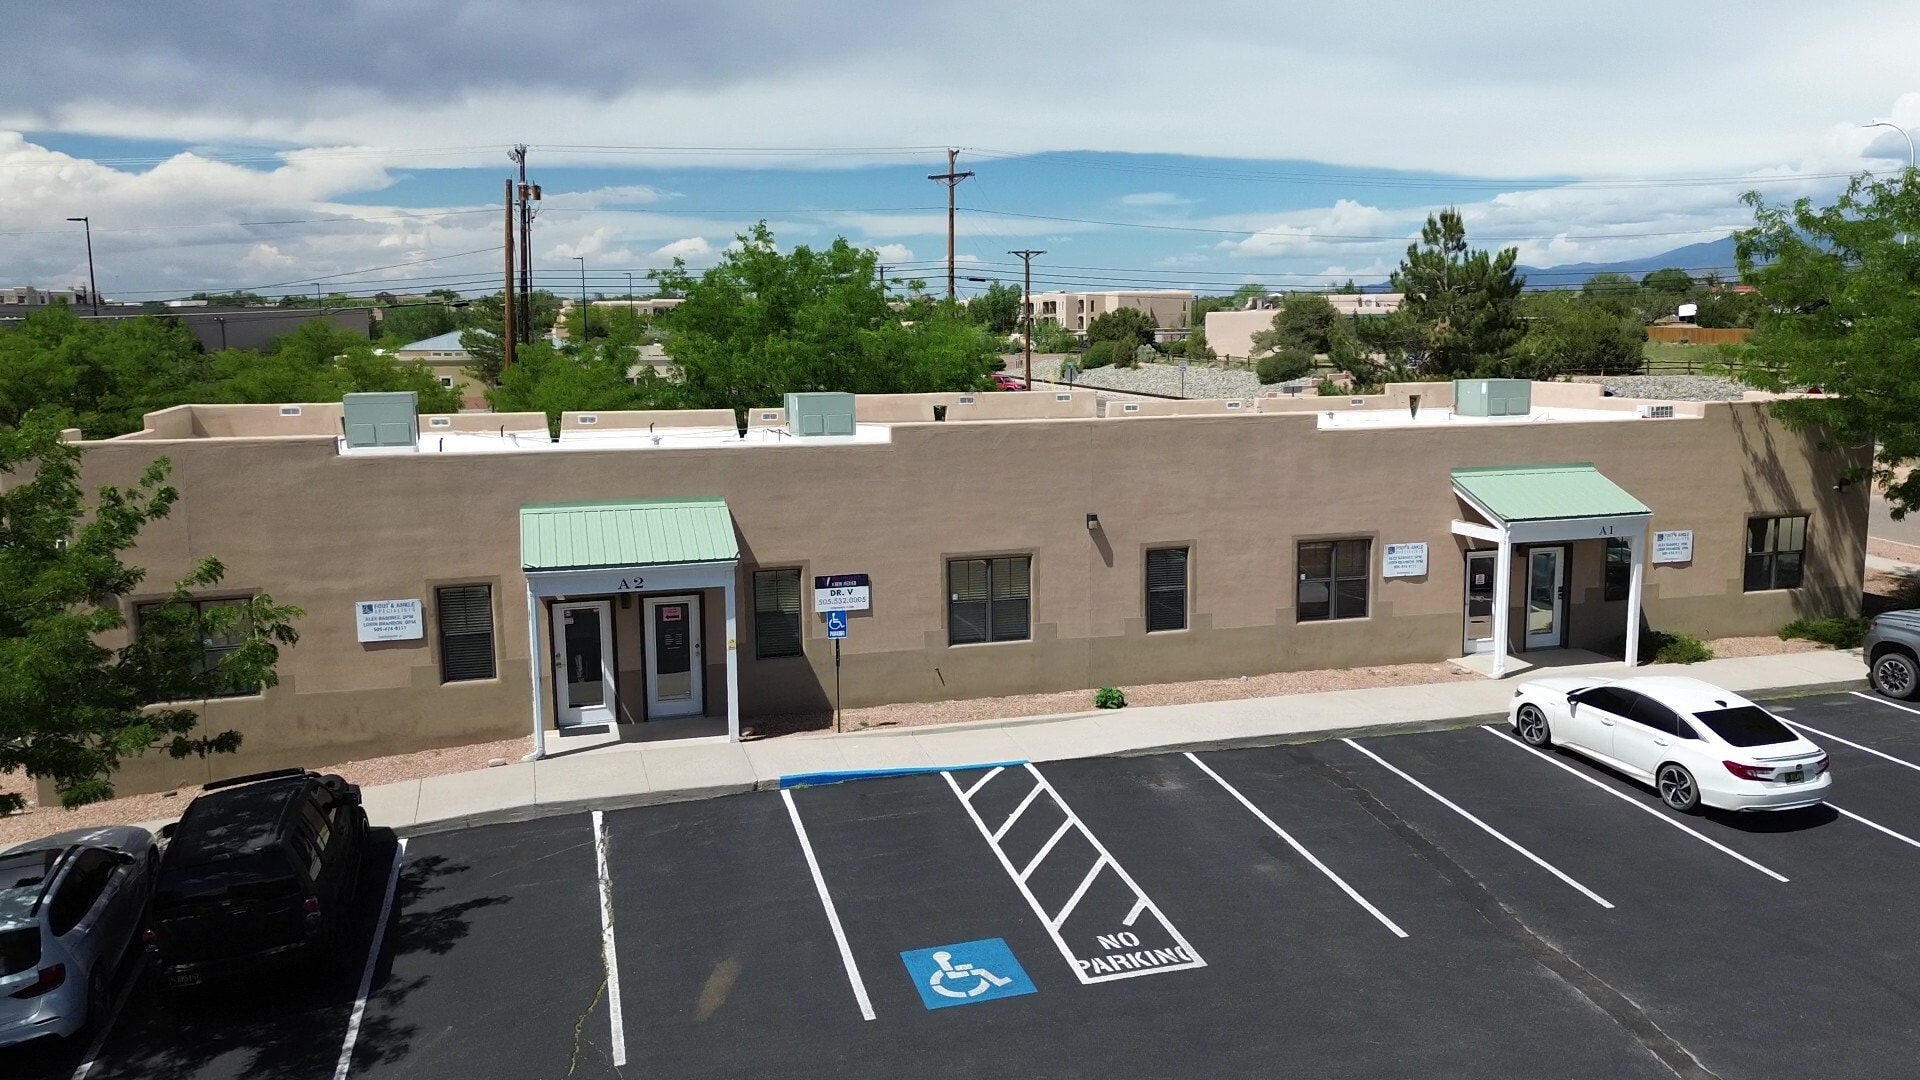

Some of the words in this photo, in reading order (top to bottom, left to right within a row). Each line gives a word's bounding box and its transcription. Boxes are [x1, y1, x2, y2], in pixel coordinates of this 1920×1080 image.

[1599, 525, 1613, 535] A1
[830, 589, 845, 597] DR.
[1096, 931, 1141, 950] NO
